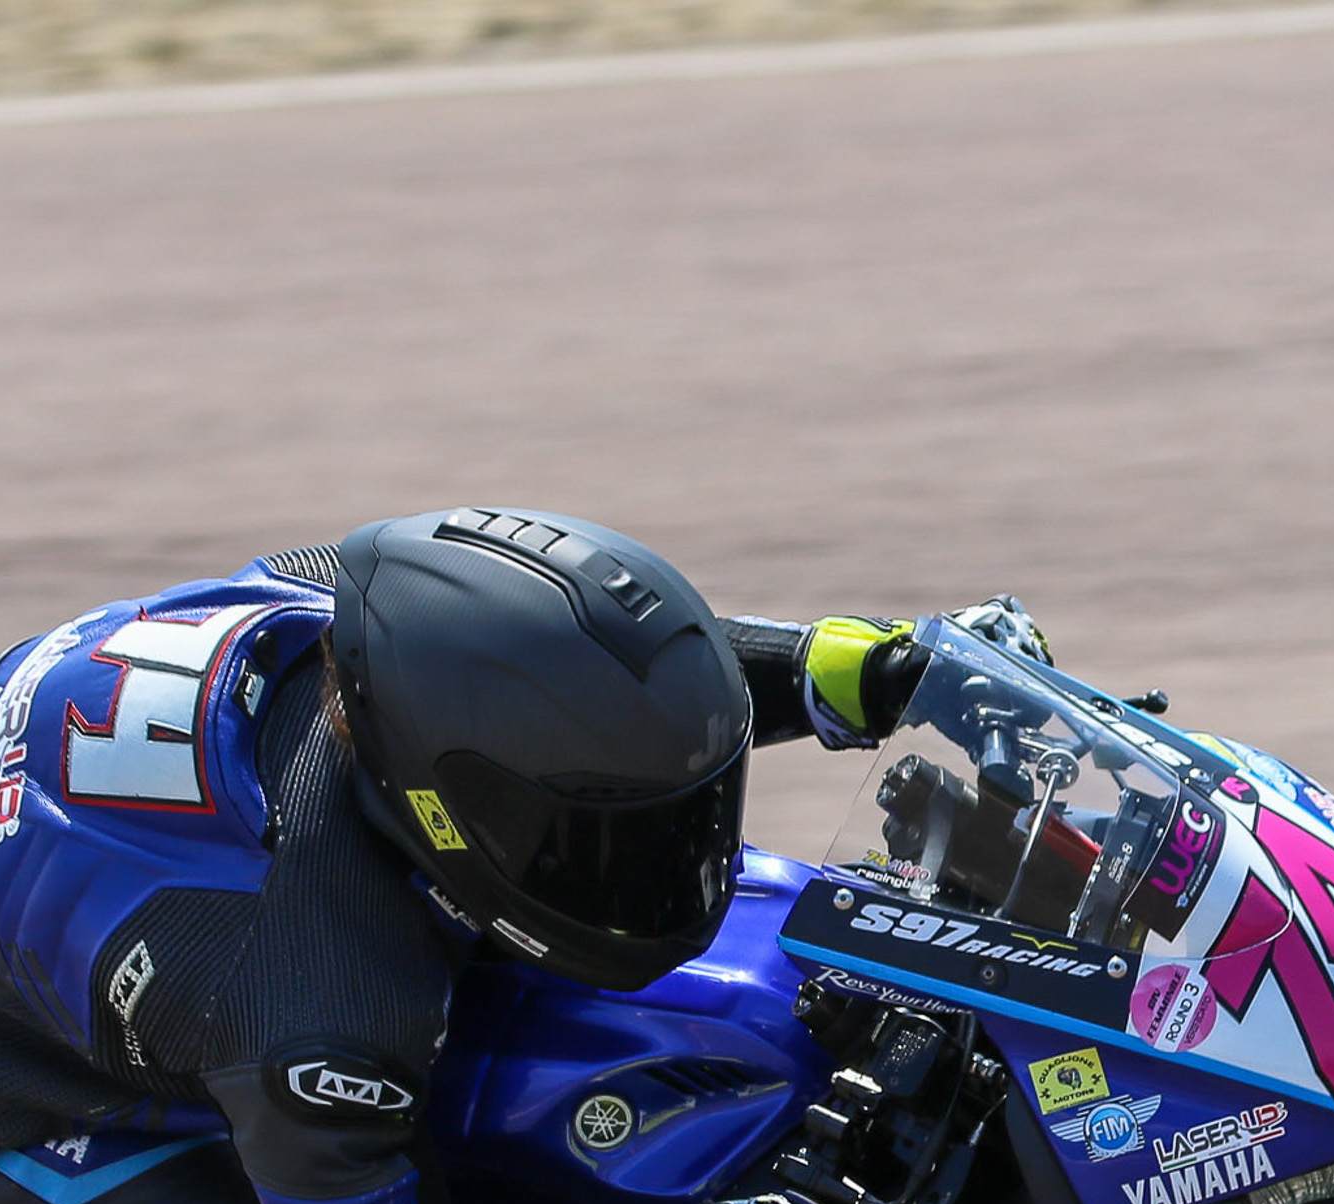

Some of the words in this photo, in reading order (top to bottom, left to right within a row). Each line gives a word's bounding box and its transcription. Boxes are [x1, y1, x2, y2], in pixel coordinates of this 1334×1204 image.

[850, 903, 981, 947] S97
[955, 938, 1102, 977] RACING
[1146, 970, 1183, 1039] FEMMINILE
[1165, 998, 1193, 1042] ROUND
[1184, 982, 1200, 997] 3
[1038, 1055, 1095, 1085] GUAGLIONE
[1053, 1087, 1095, 1105] MOTORS
[1091, 1116, 1130, 1142] FIM
[1153, 1119, 1242, 1164] LASER
[1240, 1104, 1281, 1134] UP
